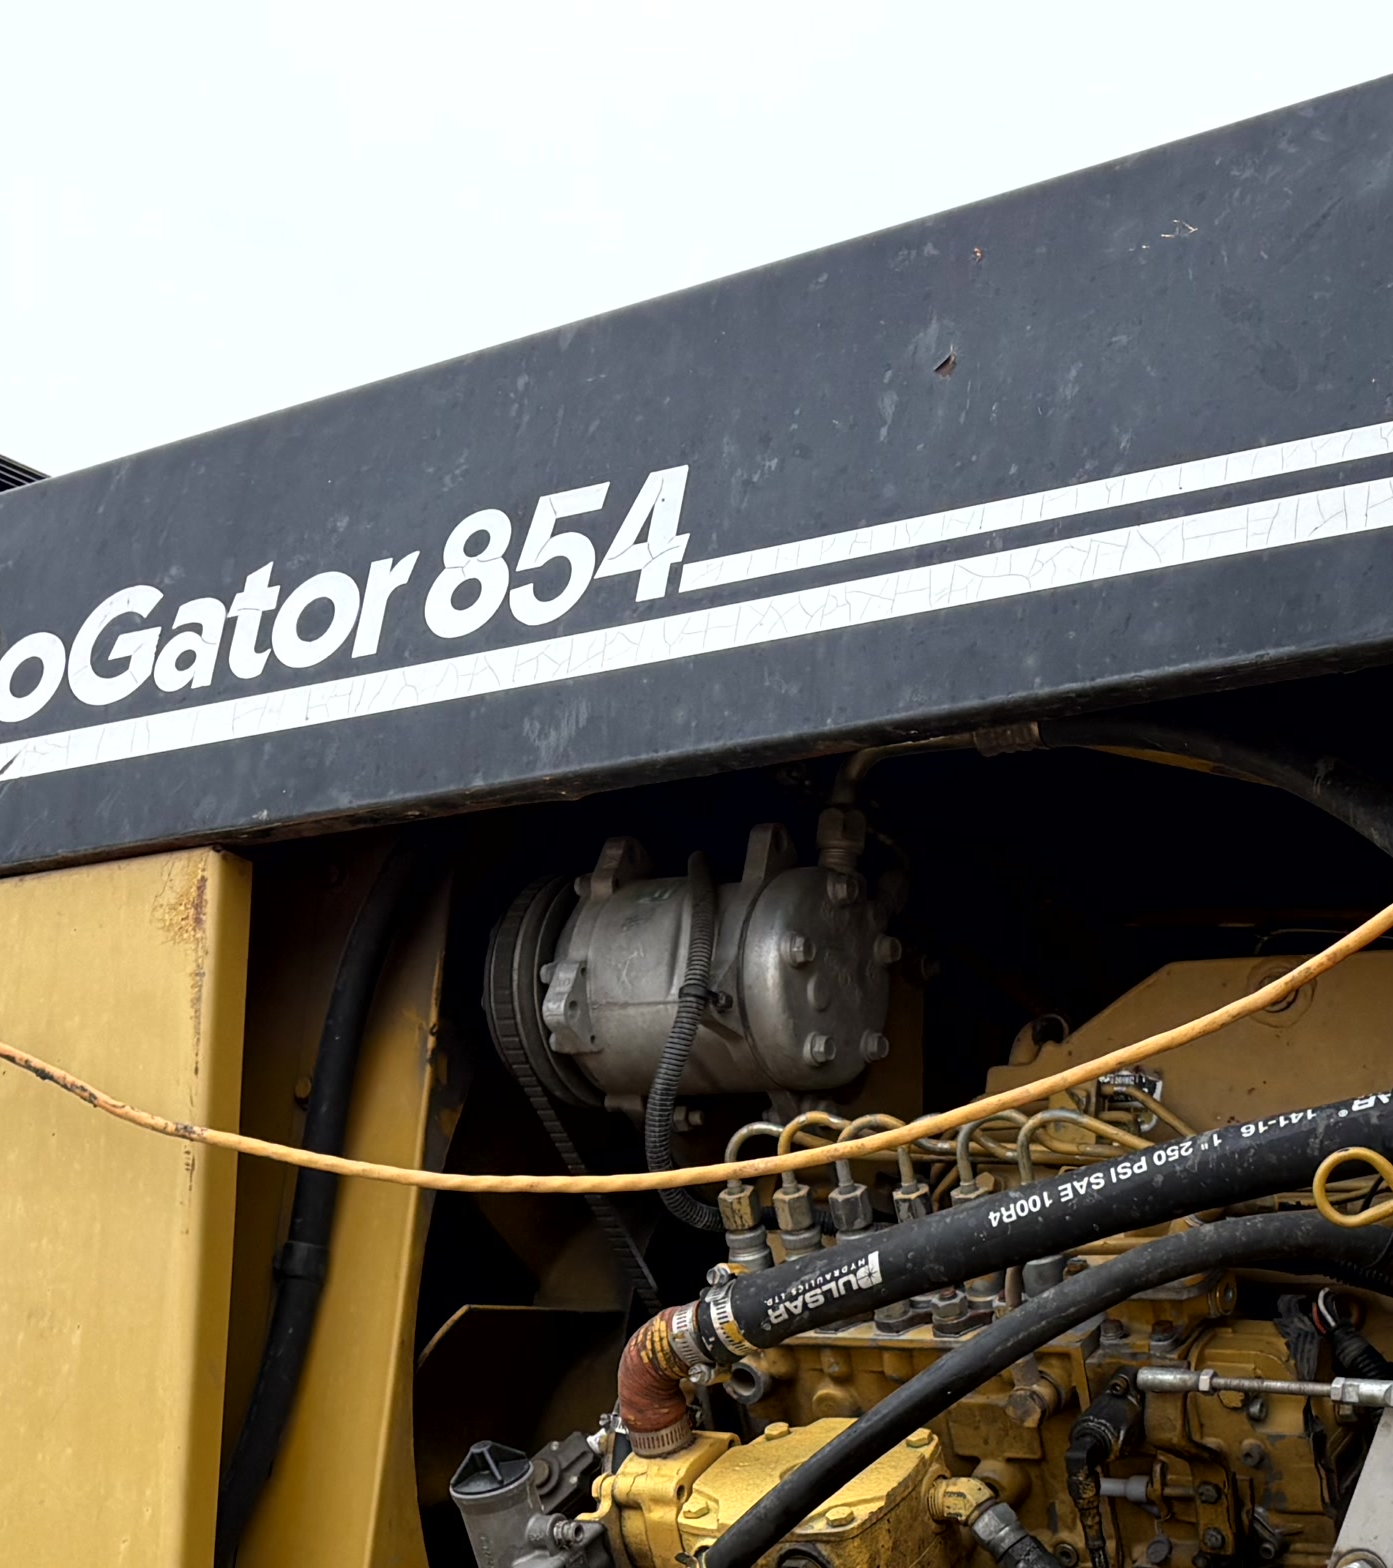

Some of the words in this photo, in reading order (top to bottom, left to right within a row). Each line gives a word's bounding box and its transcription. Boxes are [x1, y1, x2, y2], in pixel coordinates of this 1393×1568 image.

[424, 464, 689, 638] 854
[1241, 1109, 1317, 1137] 141-16
[1153, 1138, 1193, 1165] 250
[1110, 1156, 1147, 1183] PSI
[1058, 1172, 1105, 1202] SAE
[988, 1184, 1055, 1228] 100R4
[764, 1250, 882, 1323] PULSAR
[788, 1256, 868, 1296] HYDRAULICS
[762, 1291, 787, 1308] LTD.
